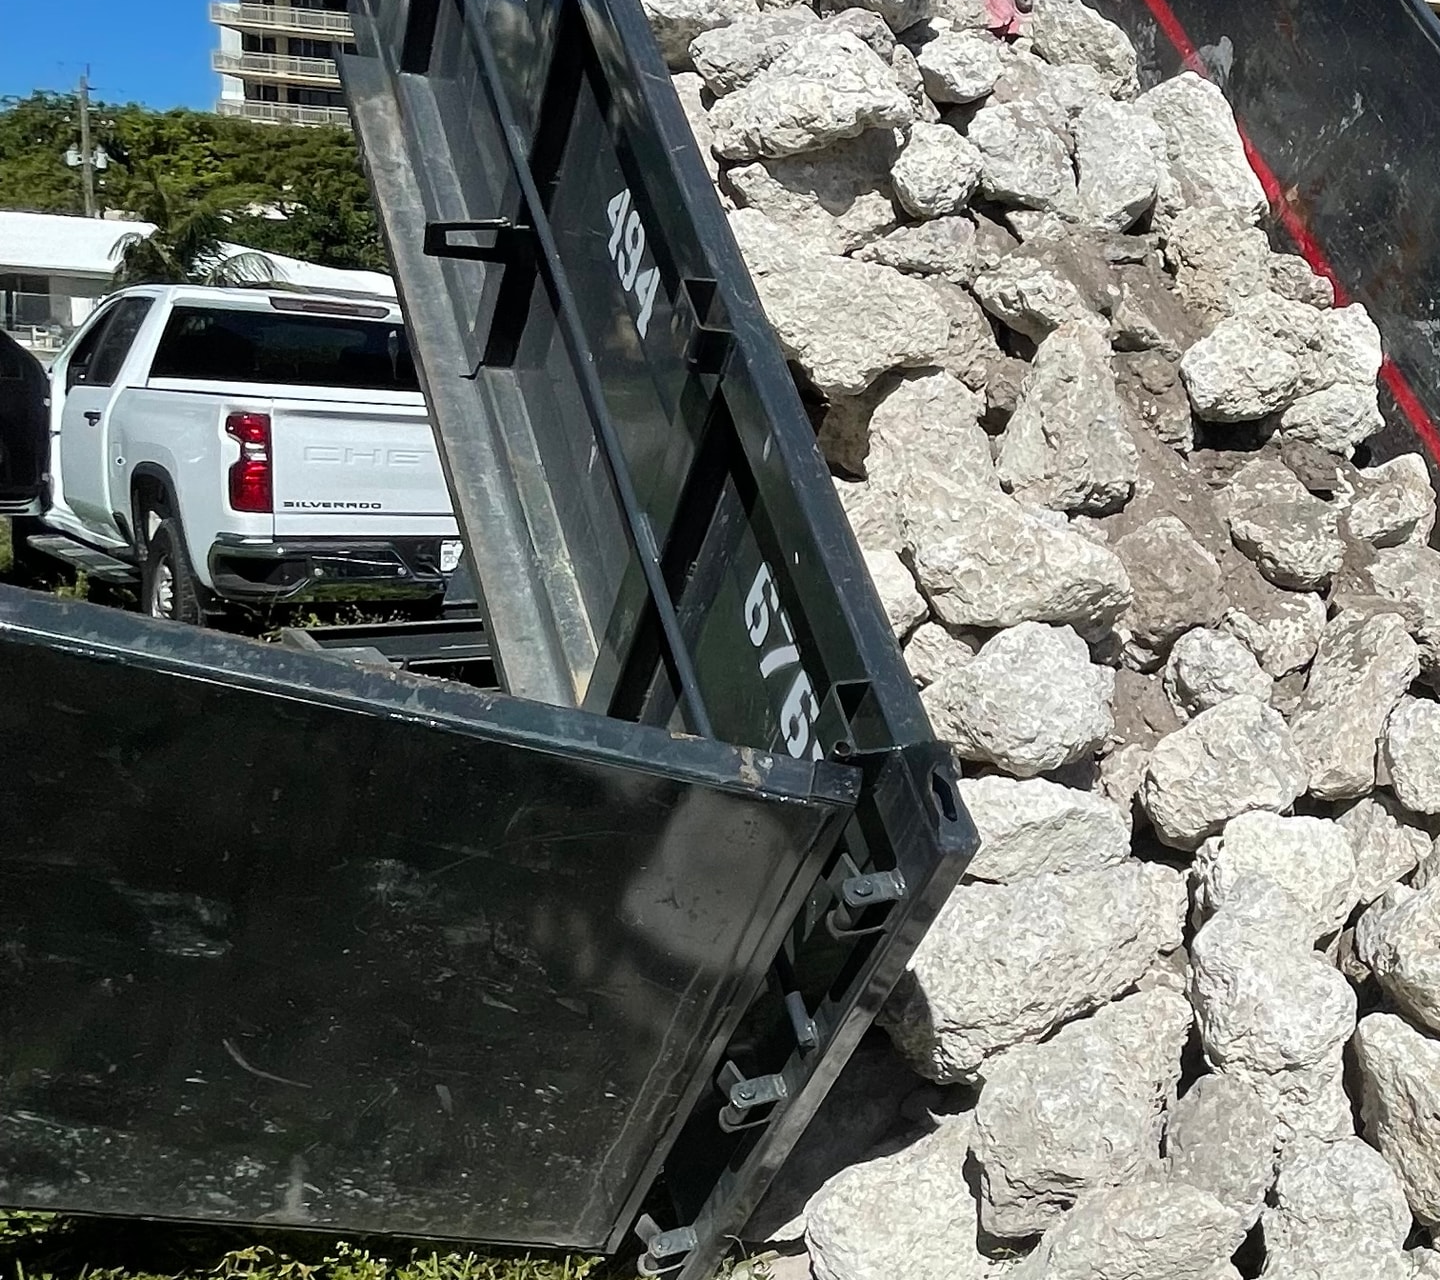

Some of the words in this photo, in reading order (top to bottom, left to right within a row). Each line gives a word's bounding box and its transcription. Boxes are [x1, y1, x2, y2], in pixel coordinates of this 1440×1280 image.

[303, 445, 434, 467] CHE
[606, 187, 661, 340] 494
[744, 560, 825, 763] 676
[282, 500, 383, 510] SILVERADO
